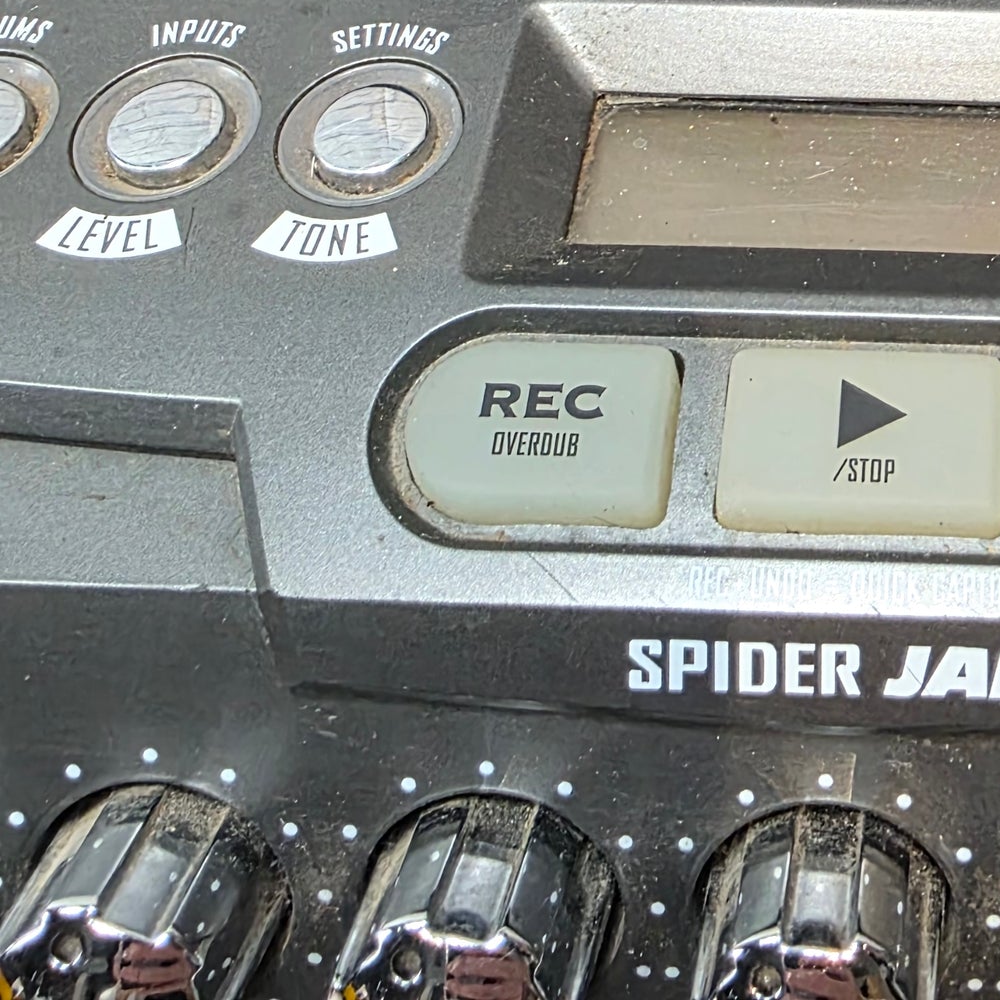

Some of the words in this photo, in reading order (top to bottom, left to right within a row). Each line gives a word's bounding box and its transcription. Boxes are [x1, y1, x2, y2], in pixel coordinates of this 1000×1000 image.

[152, 18, 246, 48] INPUTS
[331, 22, 450, 56] SETTINGS
[57, 215, 159, 253] LEVEL
[279, 219, 370, 257] TONE
[478, 382, 607, 420] REC
[491, 431, 580, 457] OVERDUB
[628, 638, 861, 697] SPIDER
